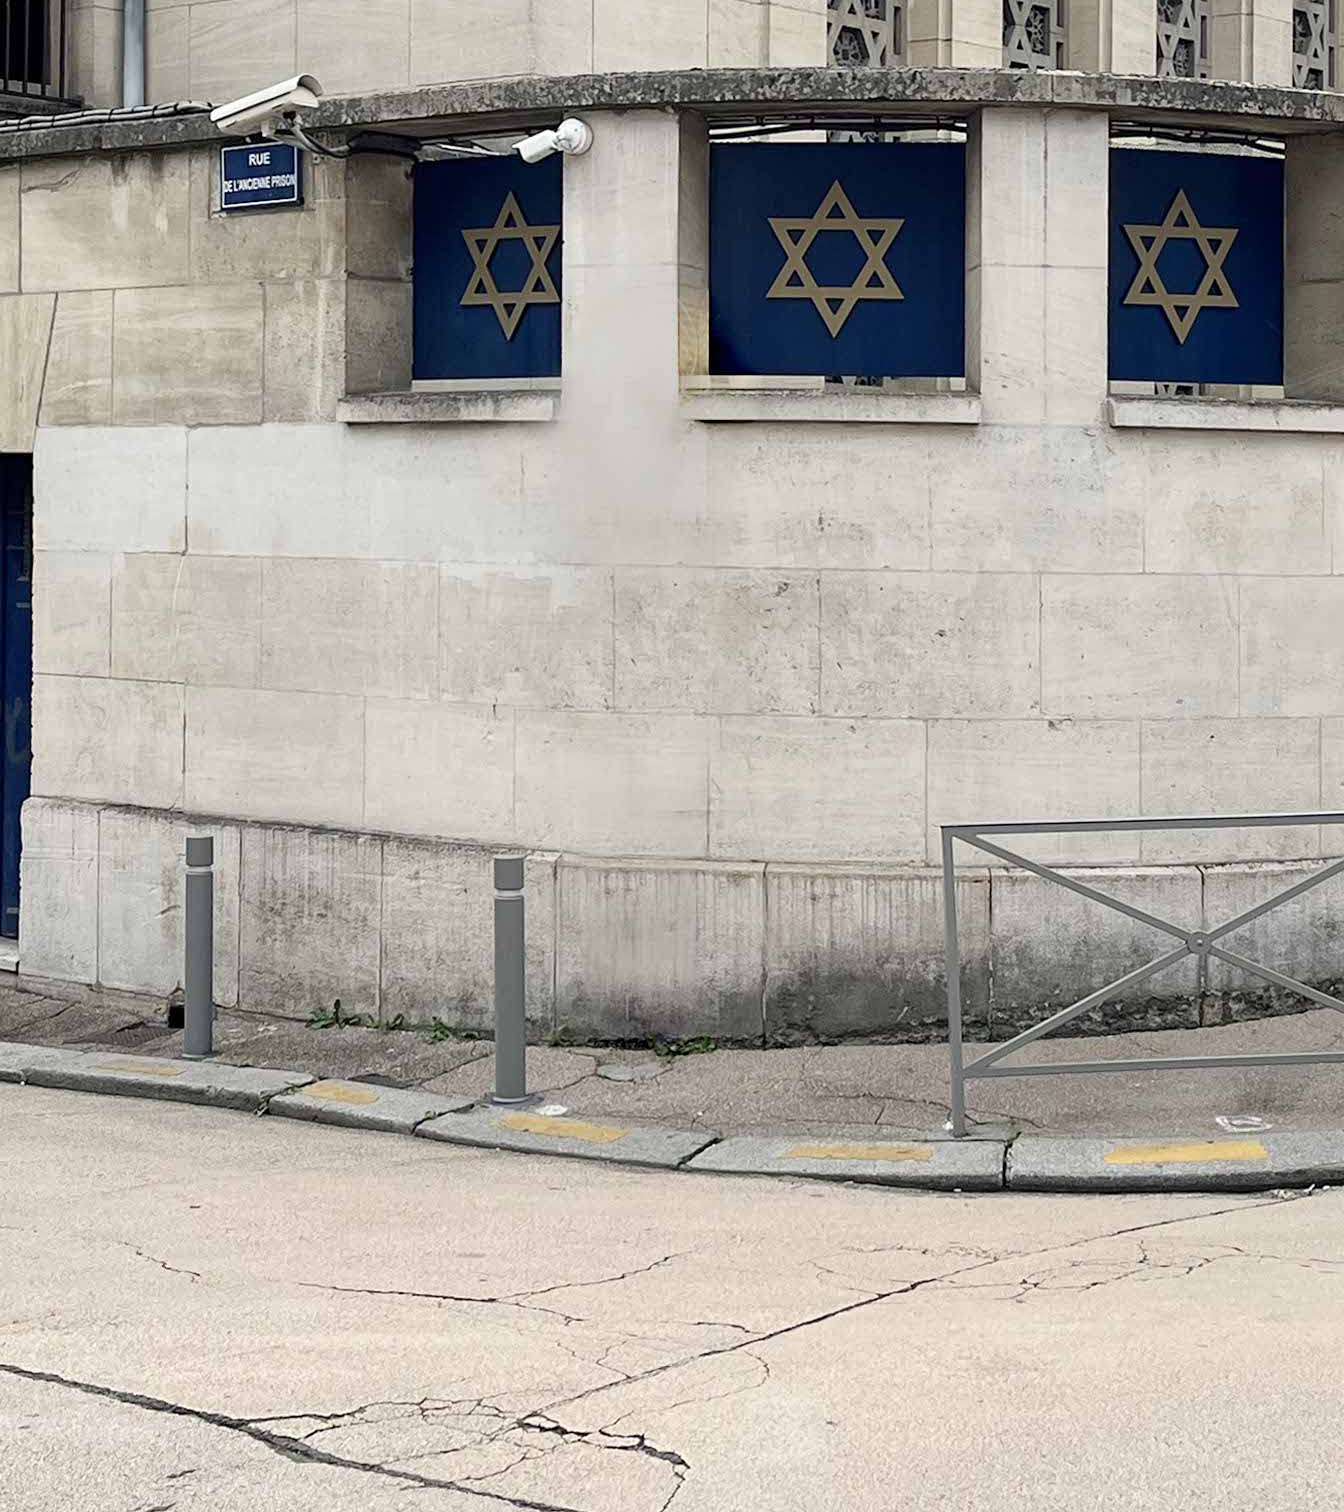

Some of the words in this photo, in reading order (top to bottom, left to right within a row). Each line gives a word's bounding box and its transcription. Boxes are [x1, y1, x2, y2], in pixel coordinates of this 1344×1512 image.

[249, 152, 270, 166] RUE
[224, 180, 233, 192] DE
[271, 174, 295, 188] PRISON
